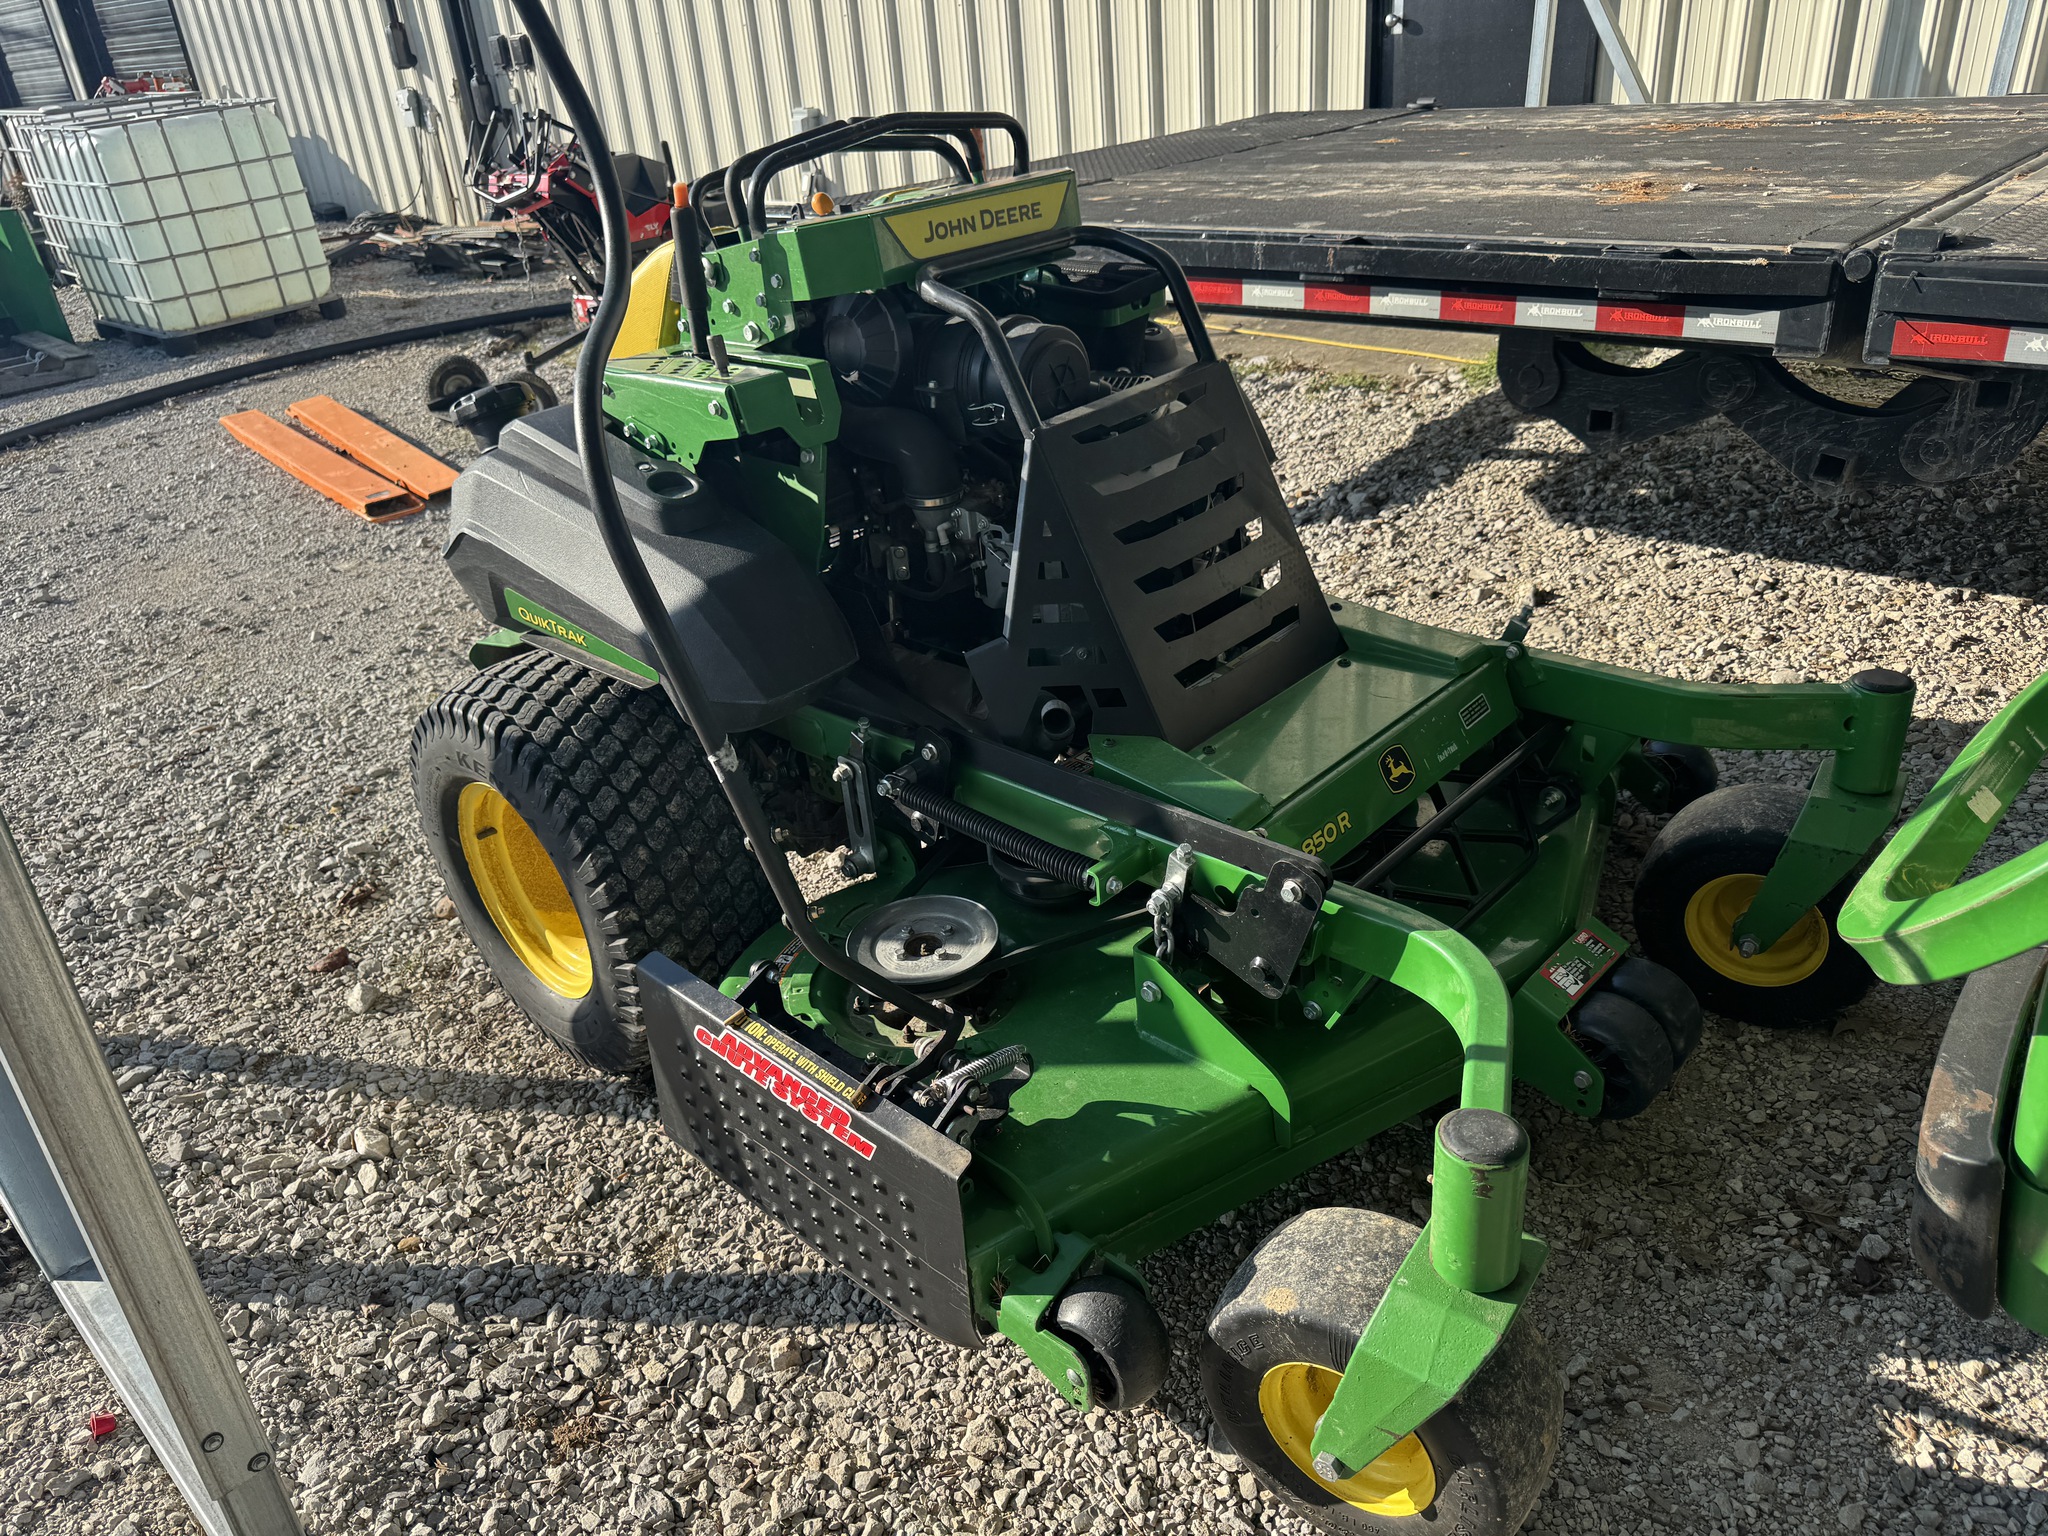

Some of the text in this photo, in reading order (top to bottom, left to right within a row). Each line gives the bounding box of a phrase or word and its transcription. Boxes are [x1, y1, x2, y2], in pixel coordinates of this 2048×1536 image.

[924, 202, 1043, 244] JOHN DEERE
[1261, 288, 1295, 298] IRONBULL
[1391, 295, 1429, 306] IRONBULL
[1463, 301, 1504, 312] IRONBULL
[1540, 306, 1584, 317] IRONBULL
[1624, 312, 1669, 323] IRONBULL
[1713, 317, 1763, 329] IRONBULL
[1929, 333, 1989, 346] IRONBULL
[517, 606, 588, 648] QUIKTRAK
[1301, 811, 1354, 857] 850 R
[734, 1015, 768, 1041] UTION:
[762, 1034, 800, 1063] OPERATE
[794, 1055, 819, 1076] WITH
[814, 1067, 846, 1093] SHIELD
[719, 1032, 851, 1127] ADVANCED
[695, 1028, 875, 1159] CHUTE SYSTEM
